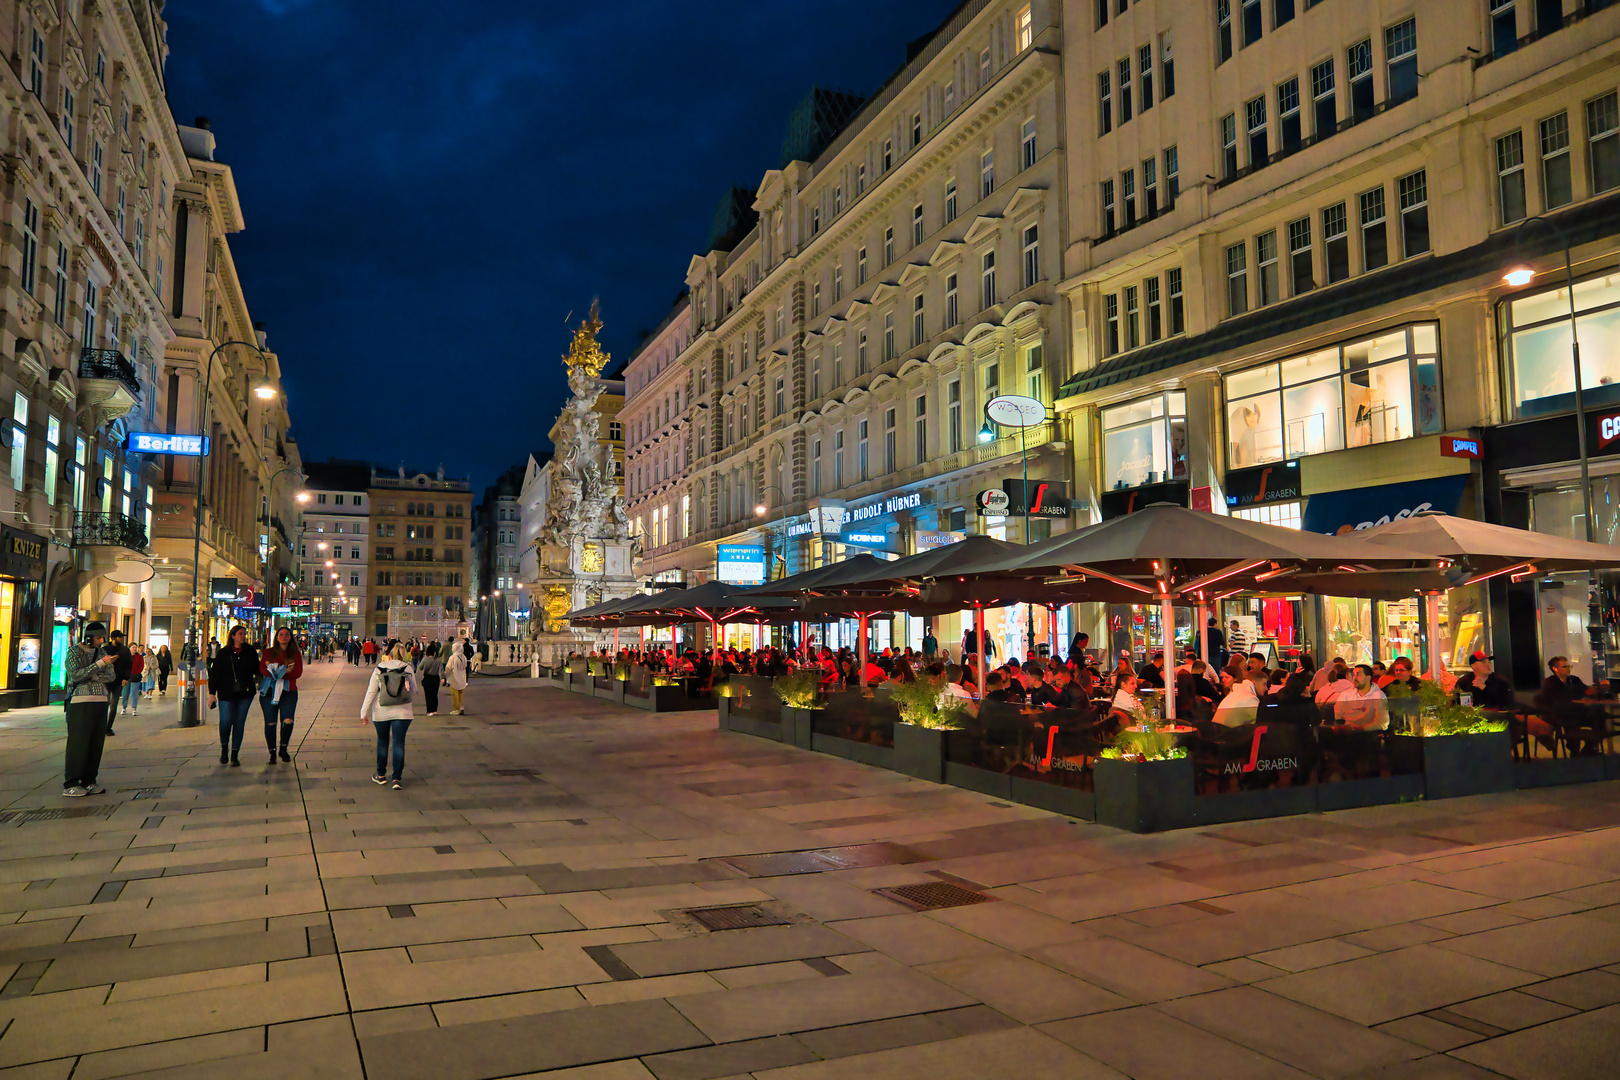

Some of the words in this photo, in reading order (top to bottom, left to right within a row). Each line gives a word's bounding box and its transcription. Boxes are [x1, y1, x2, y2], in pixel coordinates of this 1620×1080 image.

[138, 435, 201, 452] Berlitz
[1453, 439, 1478, 456] CAMPER
[1241, 494, 1254, 504] AM
[1264, 487, 1297, 500] GRABEN
[853, 503, 883, 522] RUDOLF
[886, 493, 921, 512] HÜBNER
[1039, 505, 1067, 515] GRABEN
[920, 534, 954, 544] swatch
[13, 537, 41, 559] KNIZE
[1029, 754, 1042, 764] AM
[1051, 757, 1082, 772] GRABEN
[1224, 762, 1242, 774] AM
[1256, 757, 1298, 772] GRABEN
